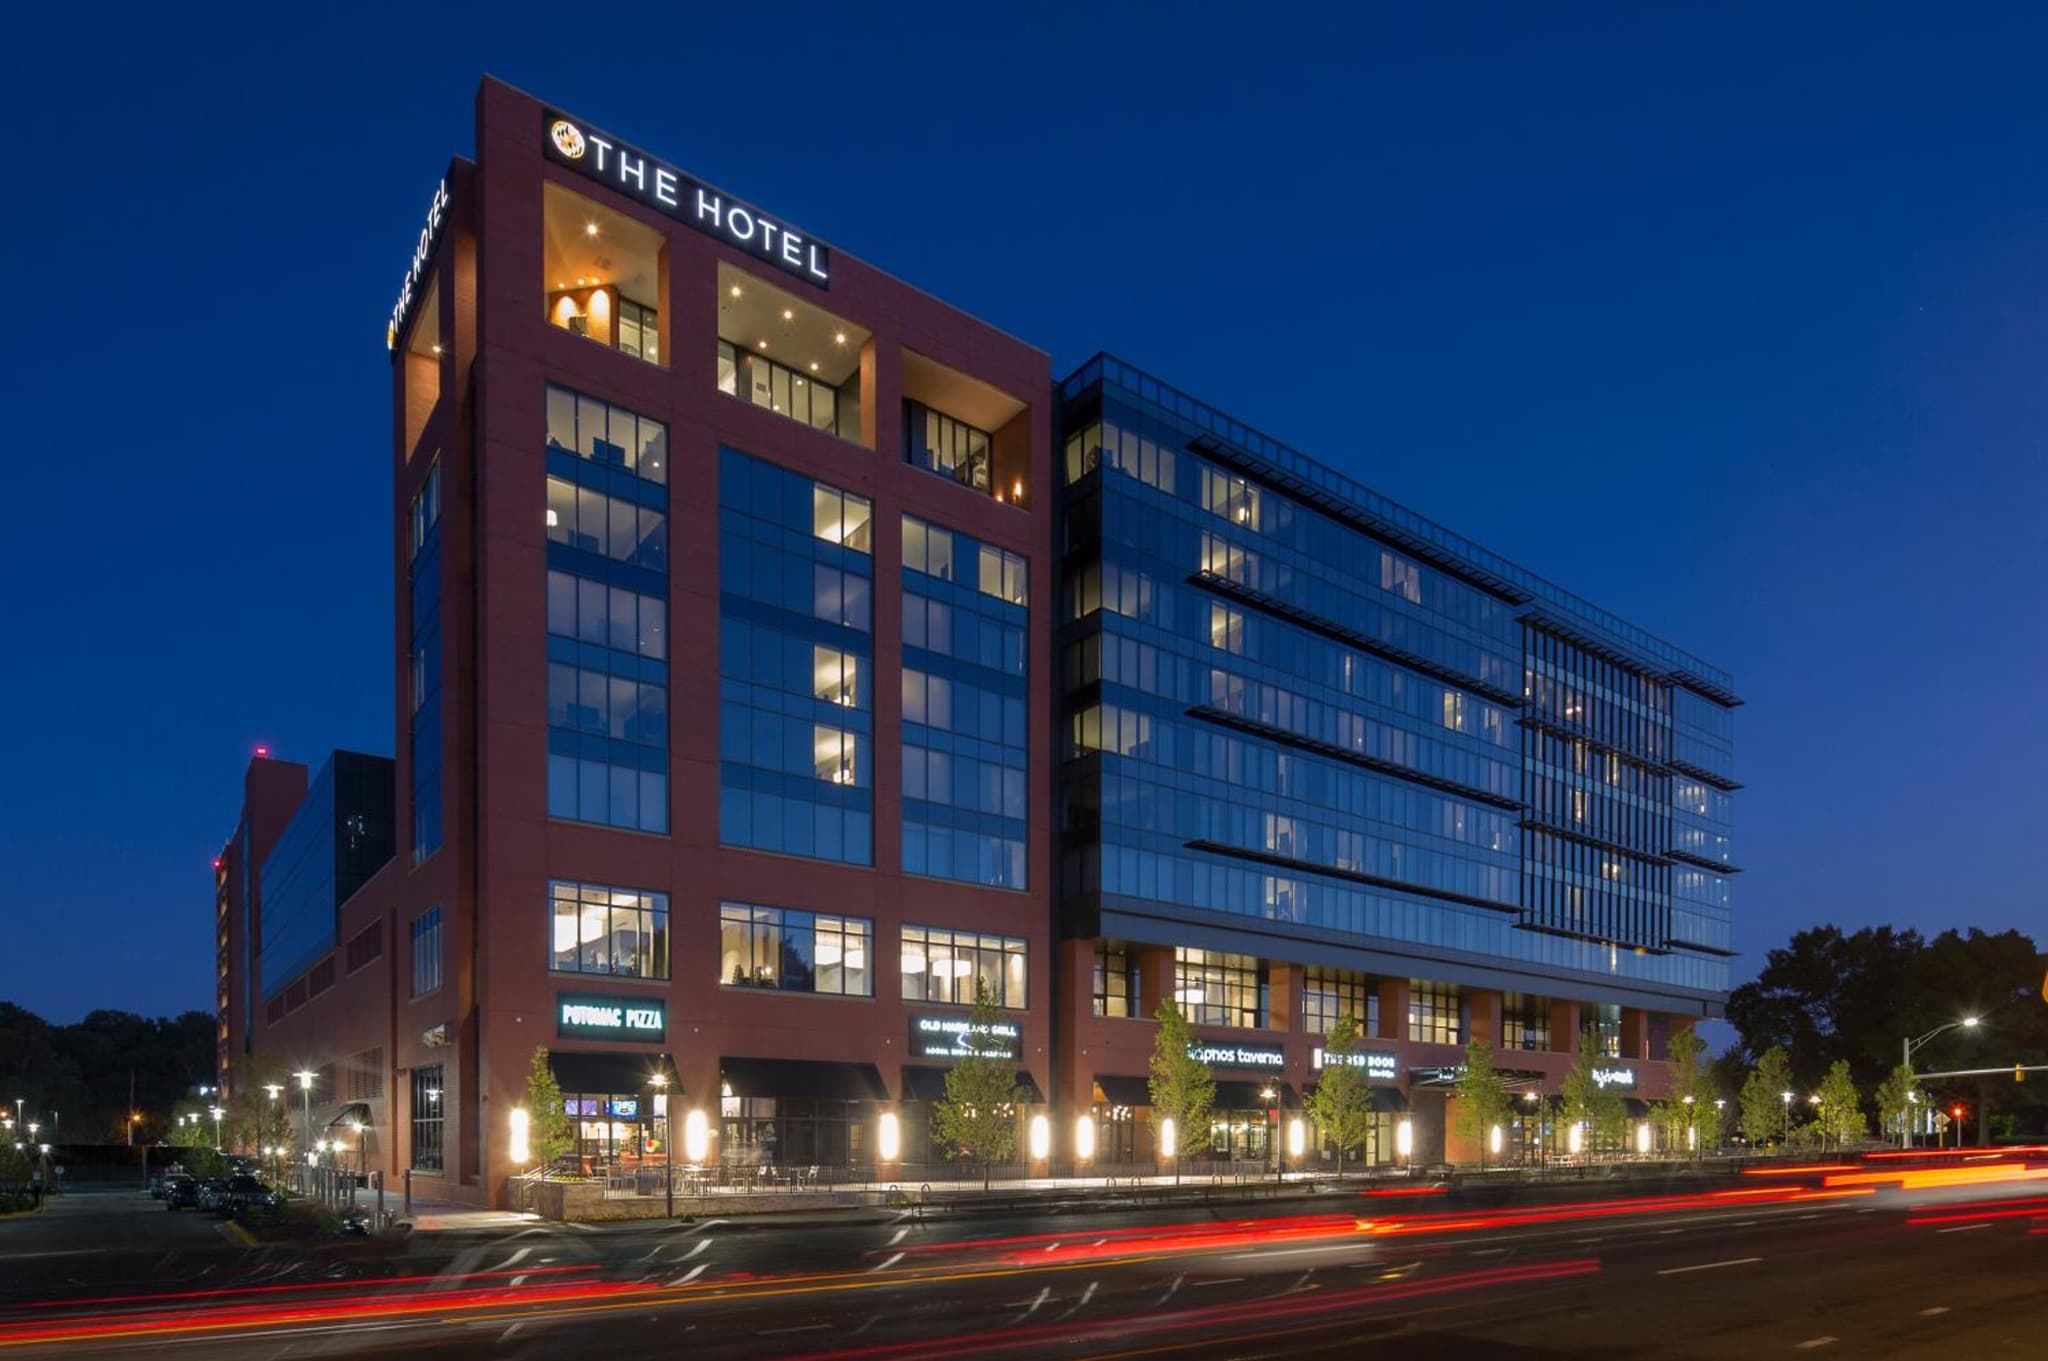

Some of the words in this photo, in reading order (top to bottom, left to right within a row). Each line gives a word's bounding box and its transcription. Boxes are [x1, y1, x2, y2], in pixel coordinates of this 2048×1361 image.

[589, 135, 677, 206] THE
[697, 189, 828, 279] HOTEL
[392, 270, 412, 334] THE
[412, 178, 449, 283] HOTEL
[562, 1004, 622, 1028] POTOMAC
[625, 1009, 663, 1029] PIZZA
[920, 1019, 941, 1032] OLD
[991, 1024, 1017, 1037] GRILL
[1236, 1048, 1284, 1065] taverna
[1323, 1052, 1343, 1065] THE
[1367, 1055, 1395, 1068] DOOR
